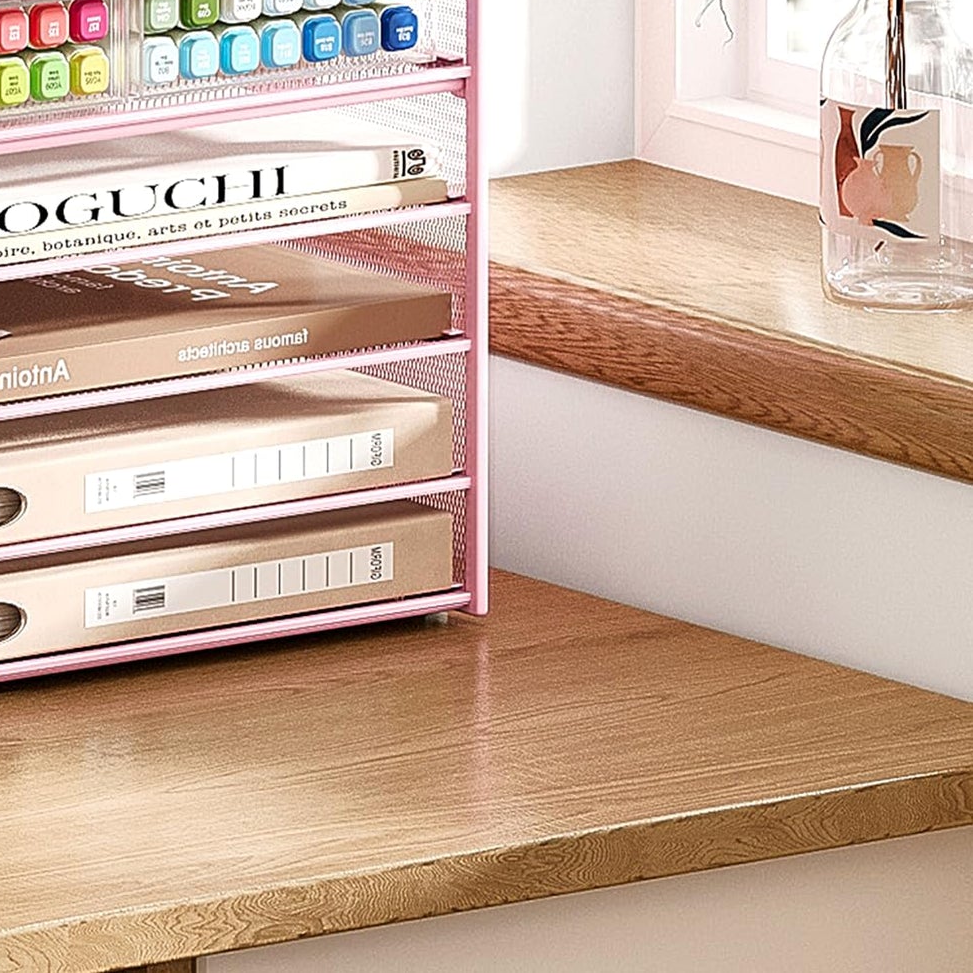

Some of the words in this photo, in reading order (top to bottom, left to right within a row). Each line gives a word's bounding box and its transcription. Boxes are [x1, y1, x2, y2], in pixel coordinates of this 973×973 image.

[43, 230, 141, 252] botanique,
[147, 221, 188, 237] arts
[194, 217, 212, 230] et
[219, 210, 273, 228] petits
[279, 199, 348, 218] secrets
